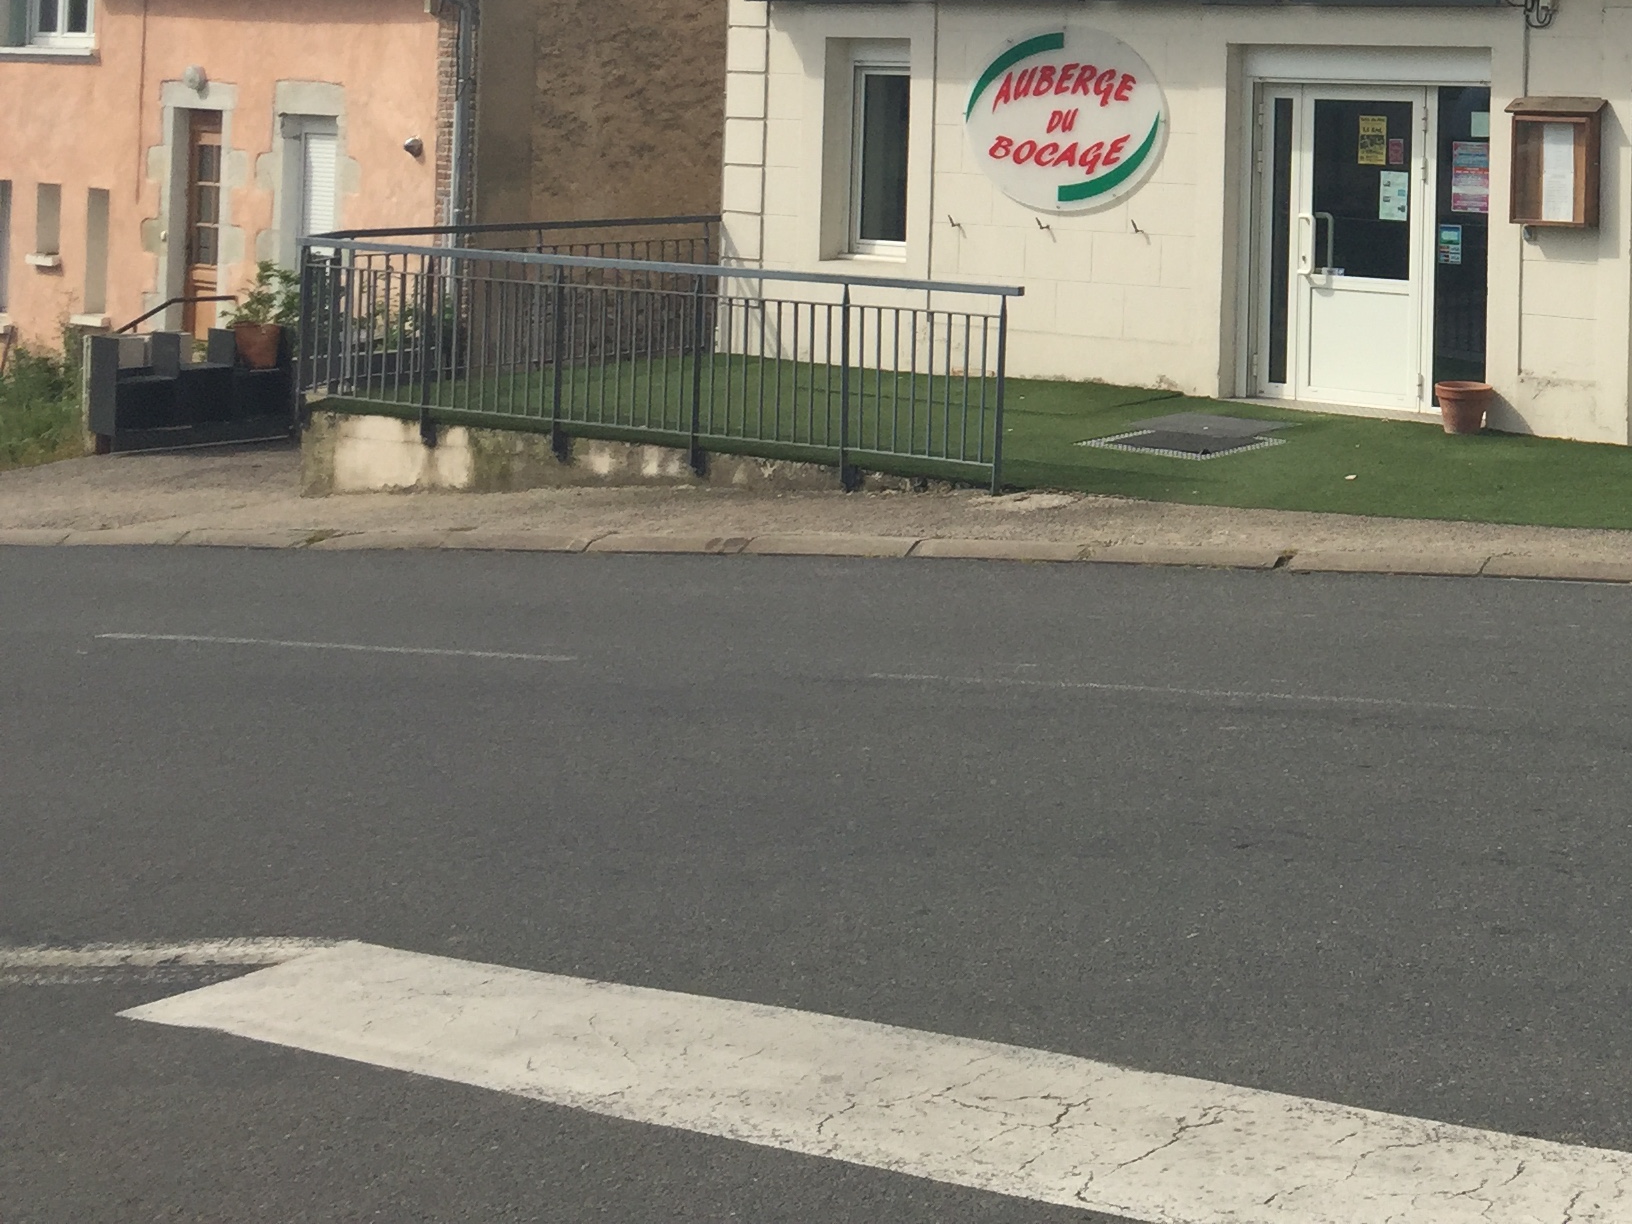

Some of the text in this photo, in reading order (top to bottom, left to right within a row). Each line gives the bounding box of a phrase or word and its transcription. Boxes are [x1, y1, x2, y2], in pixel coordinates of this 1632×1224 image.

[992, 63, 1136, 113] AUBERGE
[1046, 108, 1079, 134] DU
[988, 134, 1131, 175] BOCAGE
